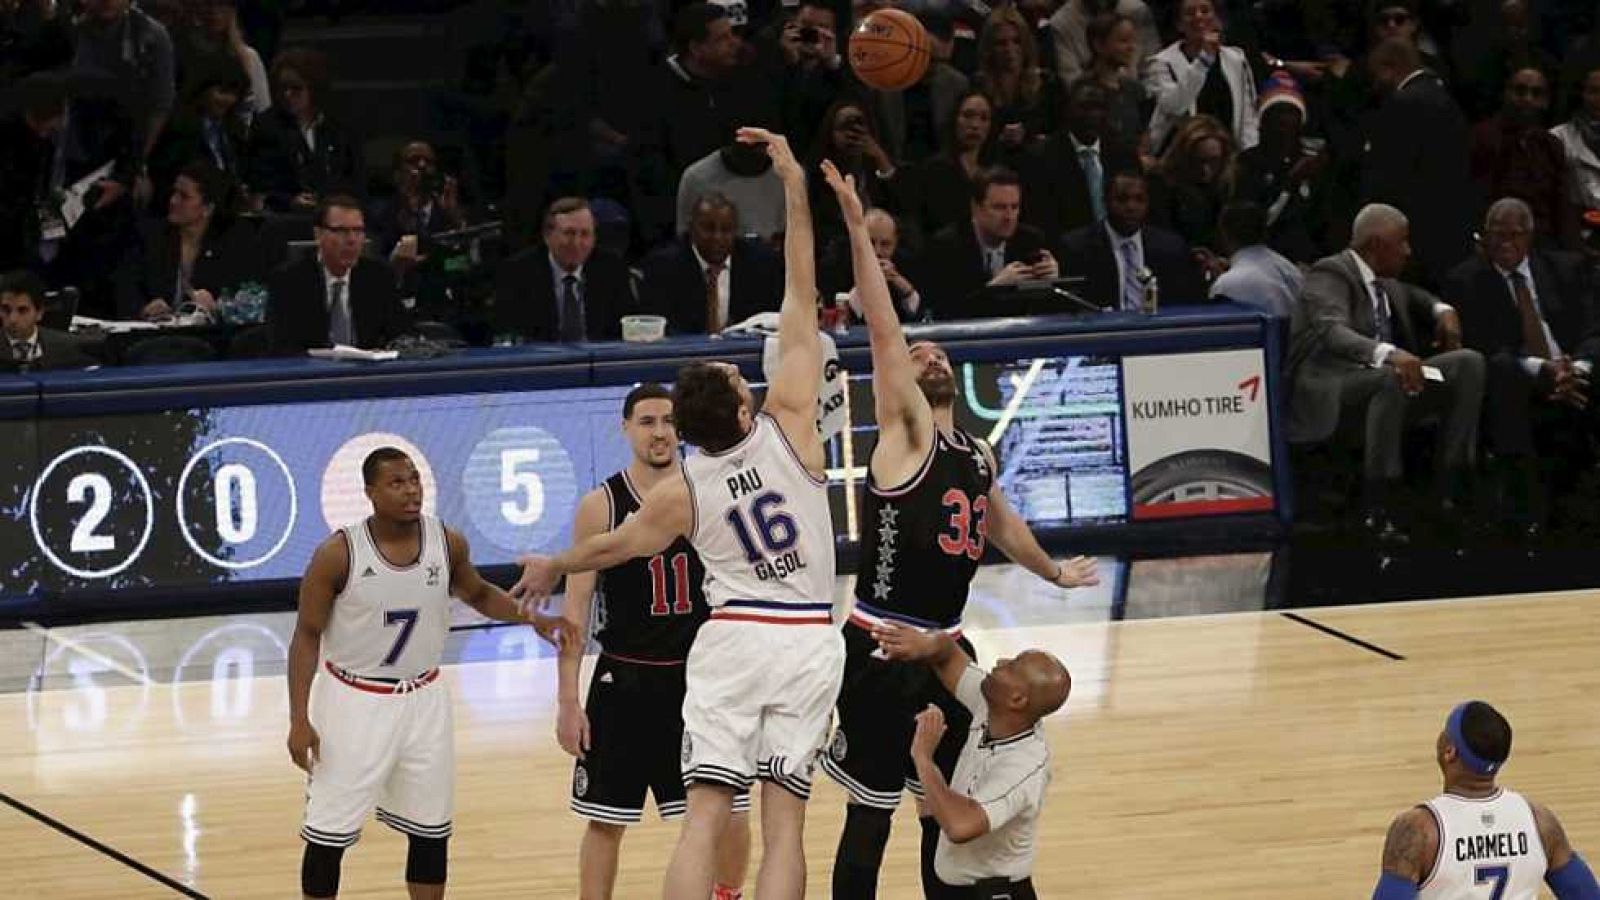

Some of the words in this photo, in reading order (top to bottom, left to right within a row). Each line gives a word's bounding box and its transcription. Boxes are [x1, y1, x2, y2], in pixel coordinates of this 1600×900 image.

[1132, 398, 1200, 419] KUMHO
[1205, 396, 1244, 414] TIRE
[66, 473, 115, 553] 2
[213, 463, 258, 544] 0
[500, 448, 544, 526] 5
[726, 466, 762, 499] PAU
[727, 490, 798, 564] 16
[938, 488, 988, 560] 33
[648, 552, 693, 615] 11
[754, 550, 807, 581] GASOL
[380, 609, 420, 667] 7
[1455, 832, 1528, 862] CARMELO
[1474, 864, 1510, 900] 7
